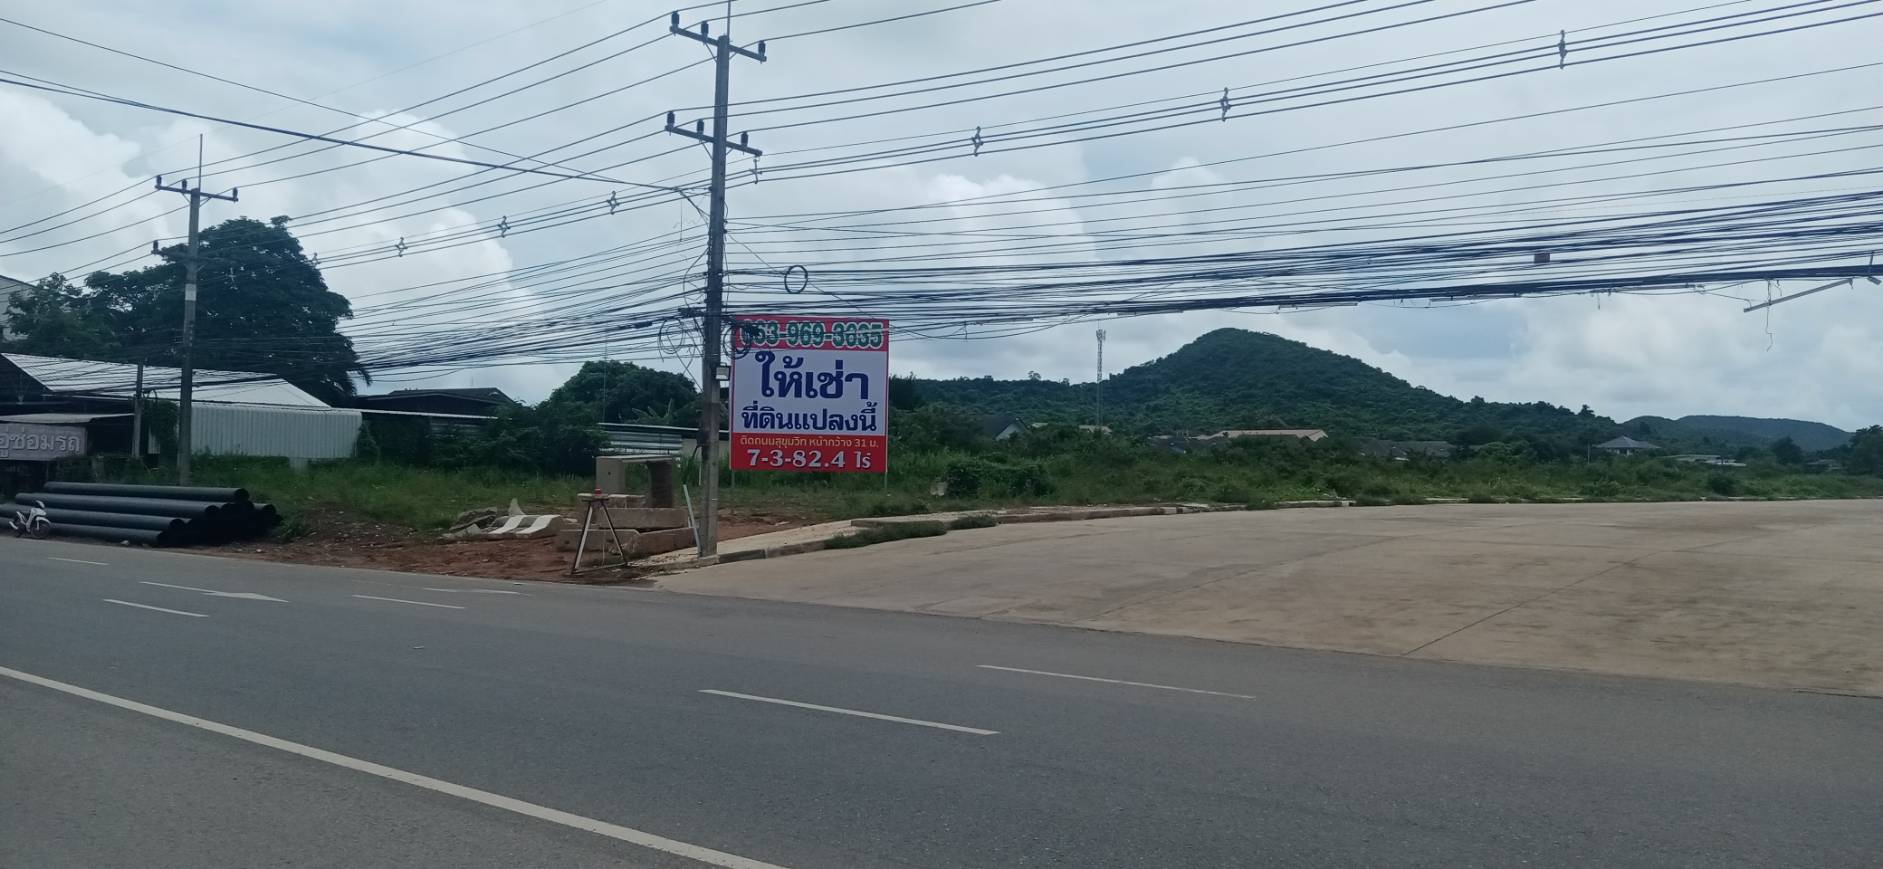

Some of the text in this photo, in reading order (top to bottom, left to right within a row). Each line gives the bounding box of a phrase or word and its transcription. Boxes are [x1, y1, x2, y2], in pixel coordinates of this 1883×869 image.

[755, 350, 869, 400] ให้เช่า
[741, 400, 878, 432] ที่ดินแปลงนี้
[740, 435, 807, 448] ติดถนนสุขุมวิท
[809, 436, 852, 447] หน้ากว้าง
[855, 438, 866, 447] 31
[747, 449, 872, 468] 7-3-82.4 ไร่
